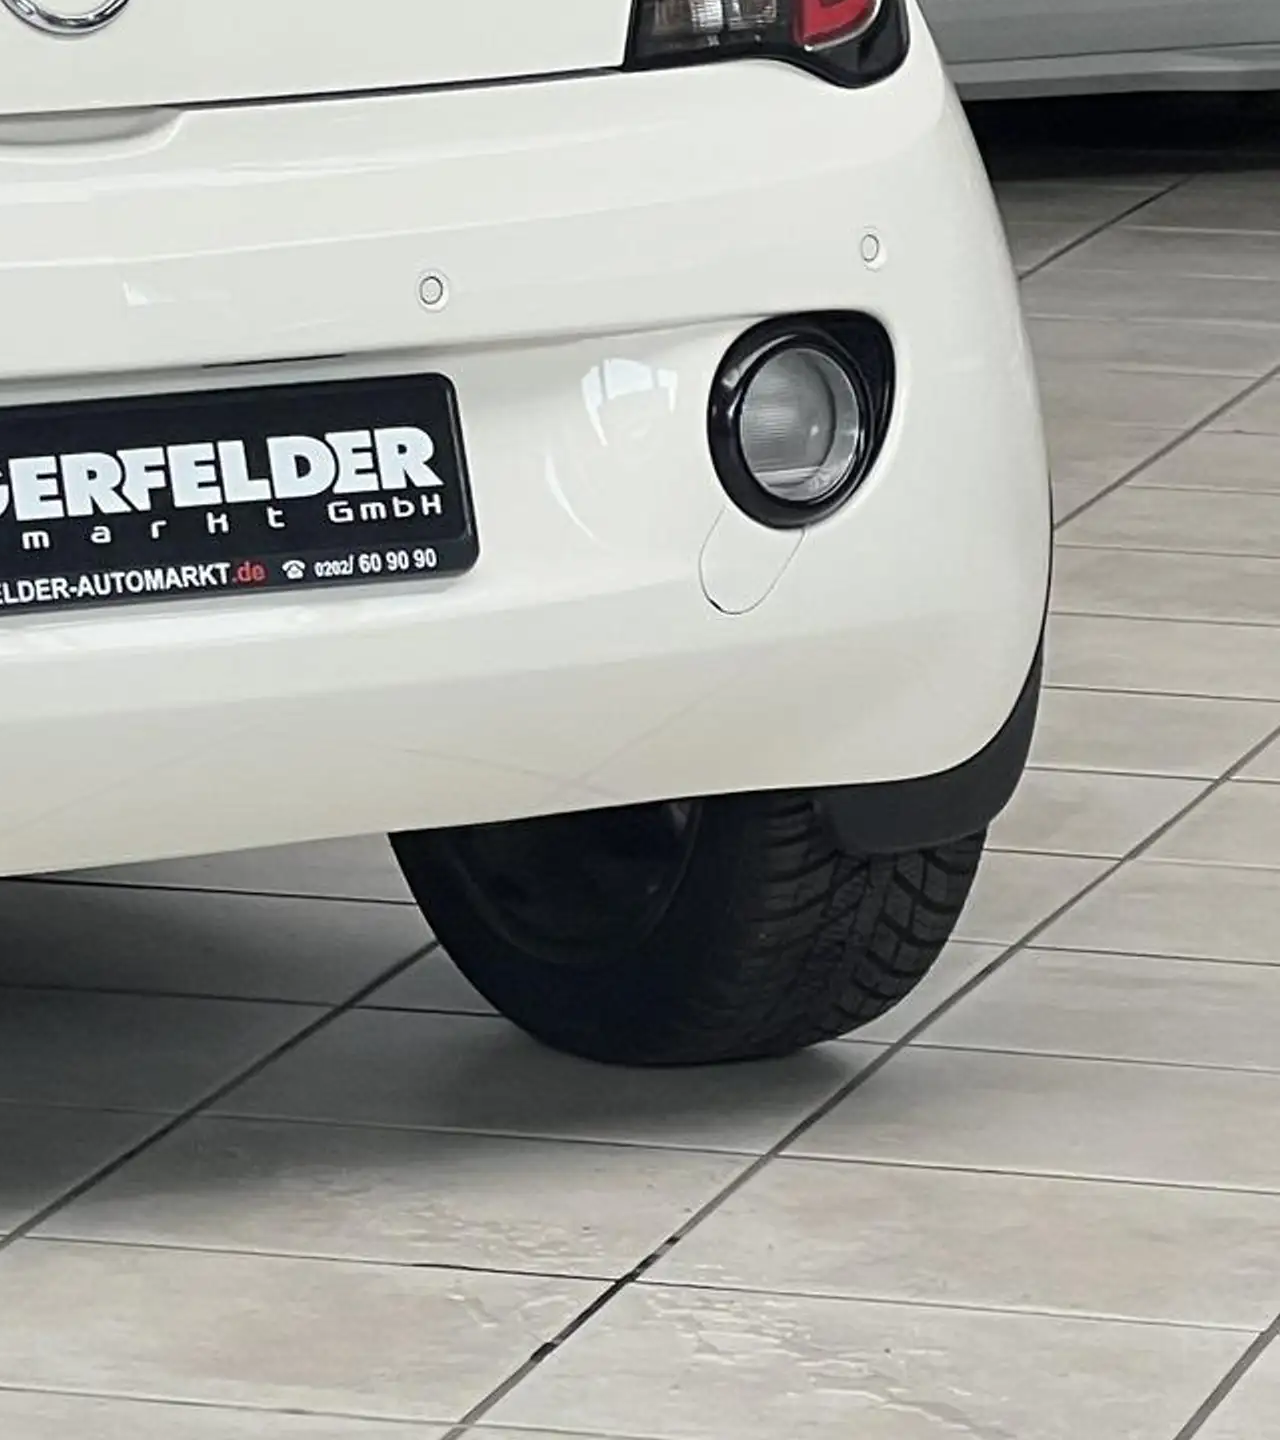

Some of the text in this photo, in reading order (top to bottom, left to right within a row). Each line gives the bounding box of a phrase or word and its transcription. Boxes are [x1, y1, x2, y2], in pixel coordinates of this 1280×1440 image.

[327, 493, 443, 523] GmbH
[357, 552, 382, 574] 60
[385, 549, 410, 572] 90
[412, 547, 437, 569] 90
